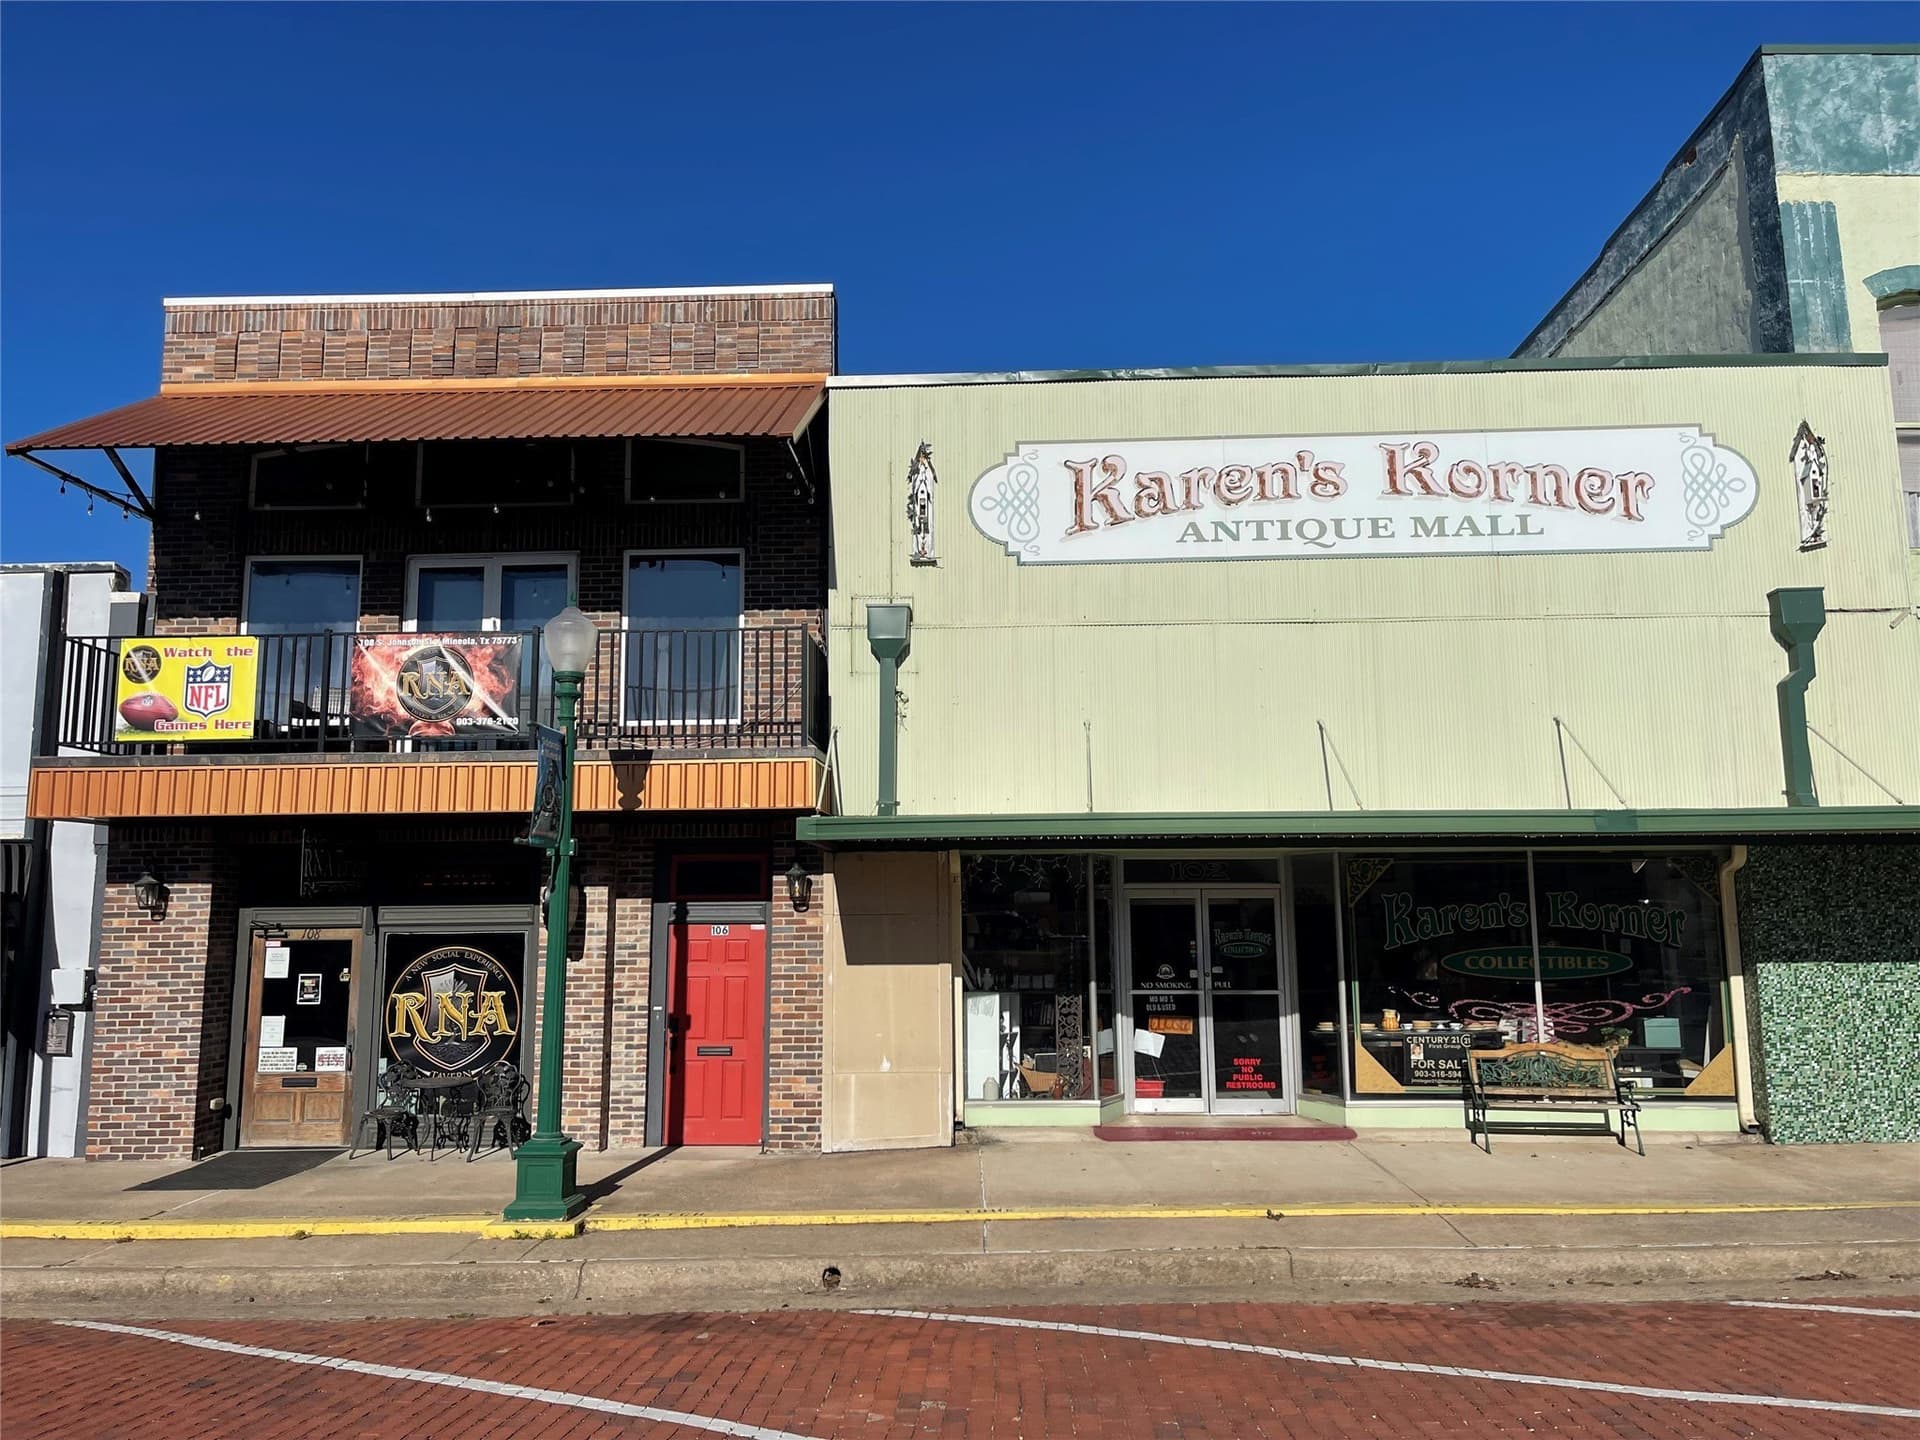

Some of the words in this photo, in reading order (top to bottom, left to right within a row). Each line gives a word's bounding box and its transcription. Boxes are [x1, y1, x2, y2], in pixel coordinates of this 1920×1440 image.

[1064, 450, 1349, 537] Karen's
[1380, 440, 1656, 522] Korner
[1176, 514, 1396, 548] ANTIQUE
[1410, 513, 1544, 540] MALL
[492, 636, 517, 644] 75773
[163, 647, 212, 658] Watch
[226, 646, 253, 656] the
[400, 671, 471, 699] RNA
[188, 685, 225, 711] NFL
[154, 719, 207, 731] Games
[214, 718, 251, 729] Here
[1381, 891, 1529, 951] Karen's
[1546, 890, 1689, 948] Korner
[301, 928, 321, 940] 108
[711, 925, 729, 936] 106
[405, 974, 413, 982] A
[411, 958, 429, 975] NEW
[431, 951, 460, 962] SOCIAL
[464, 951, 505, 981] EXPERIENCE
[1155, 981, 1192, 989] SMOKING
[1214, 980, 1232, 989] PULL
[388, 990, 516, 1045] RNA
[1406, 1036, 1449, 1044] CENTURY
[1450, 1036, 1460, 1044] 21
[1233, 1058, 1261, 1066] SORRY
[1410, 1059, 1436, 1069] FOR
[1226, 1081, 1276, 1089] RESTROOMS
